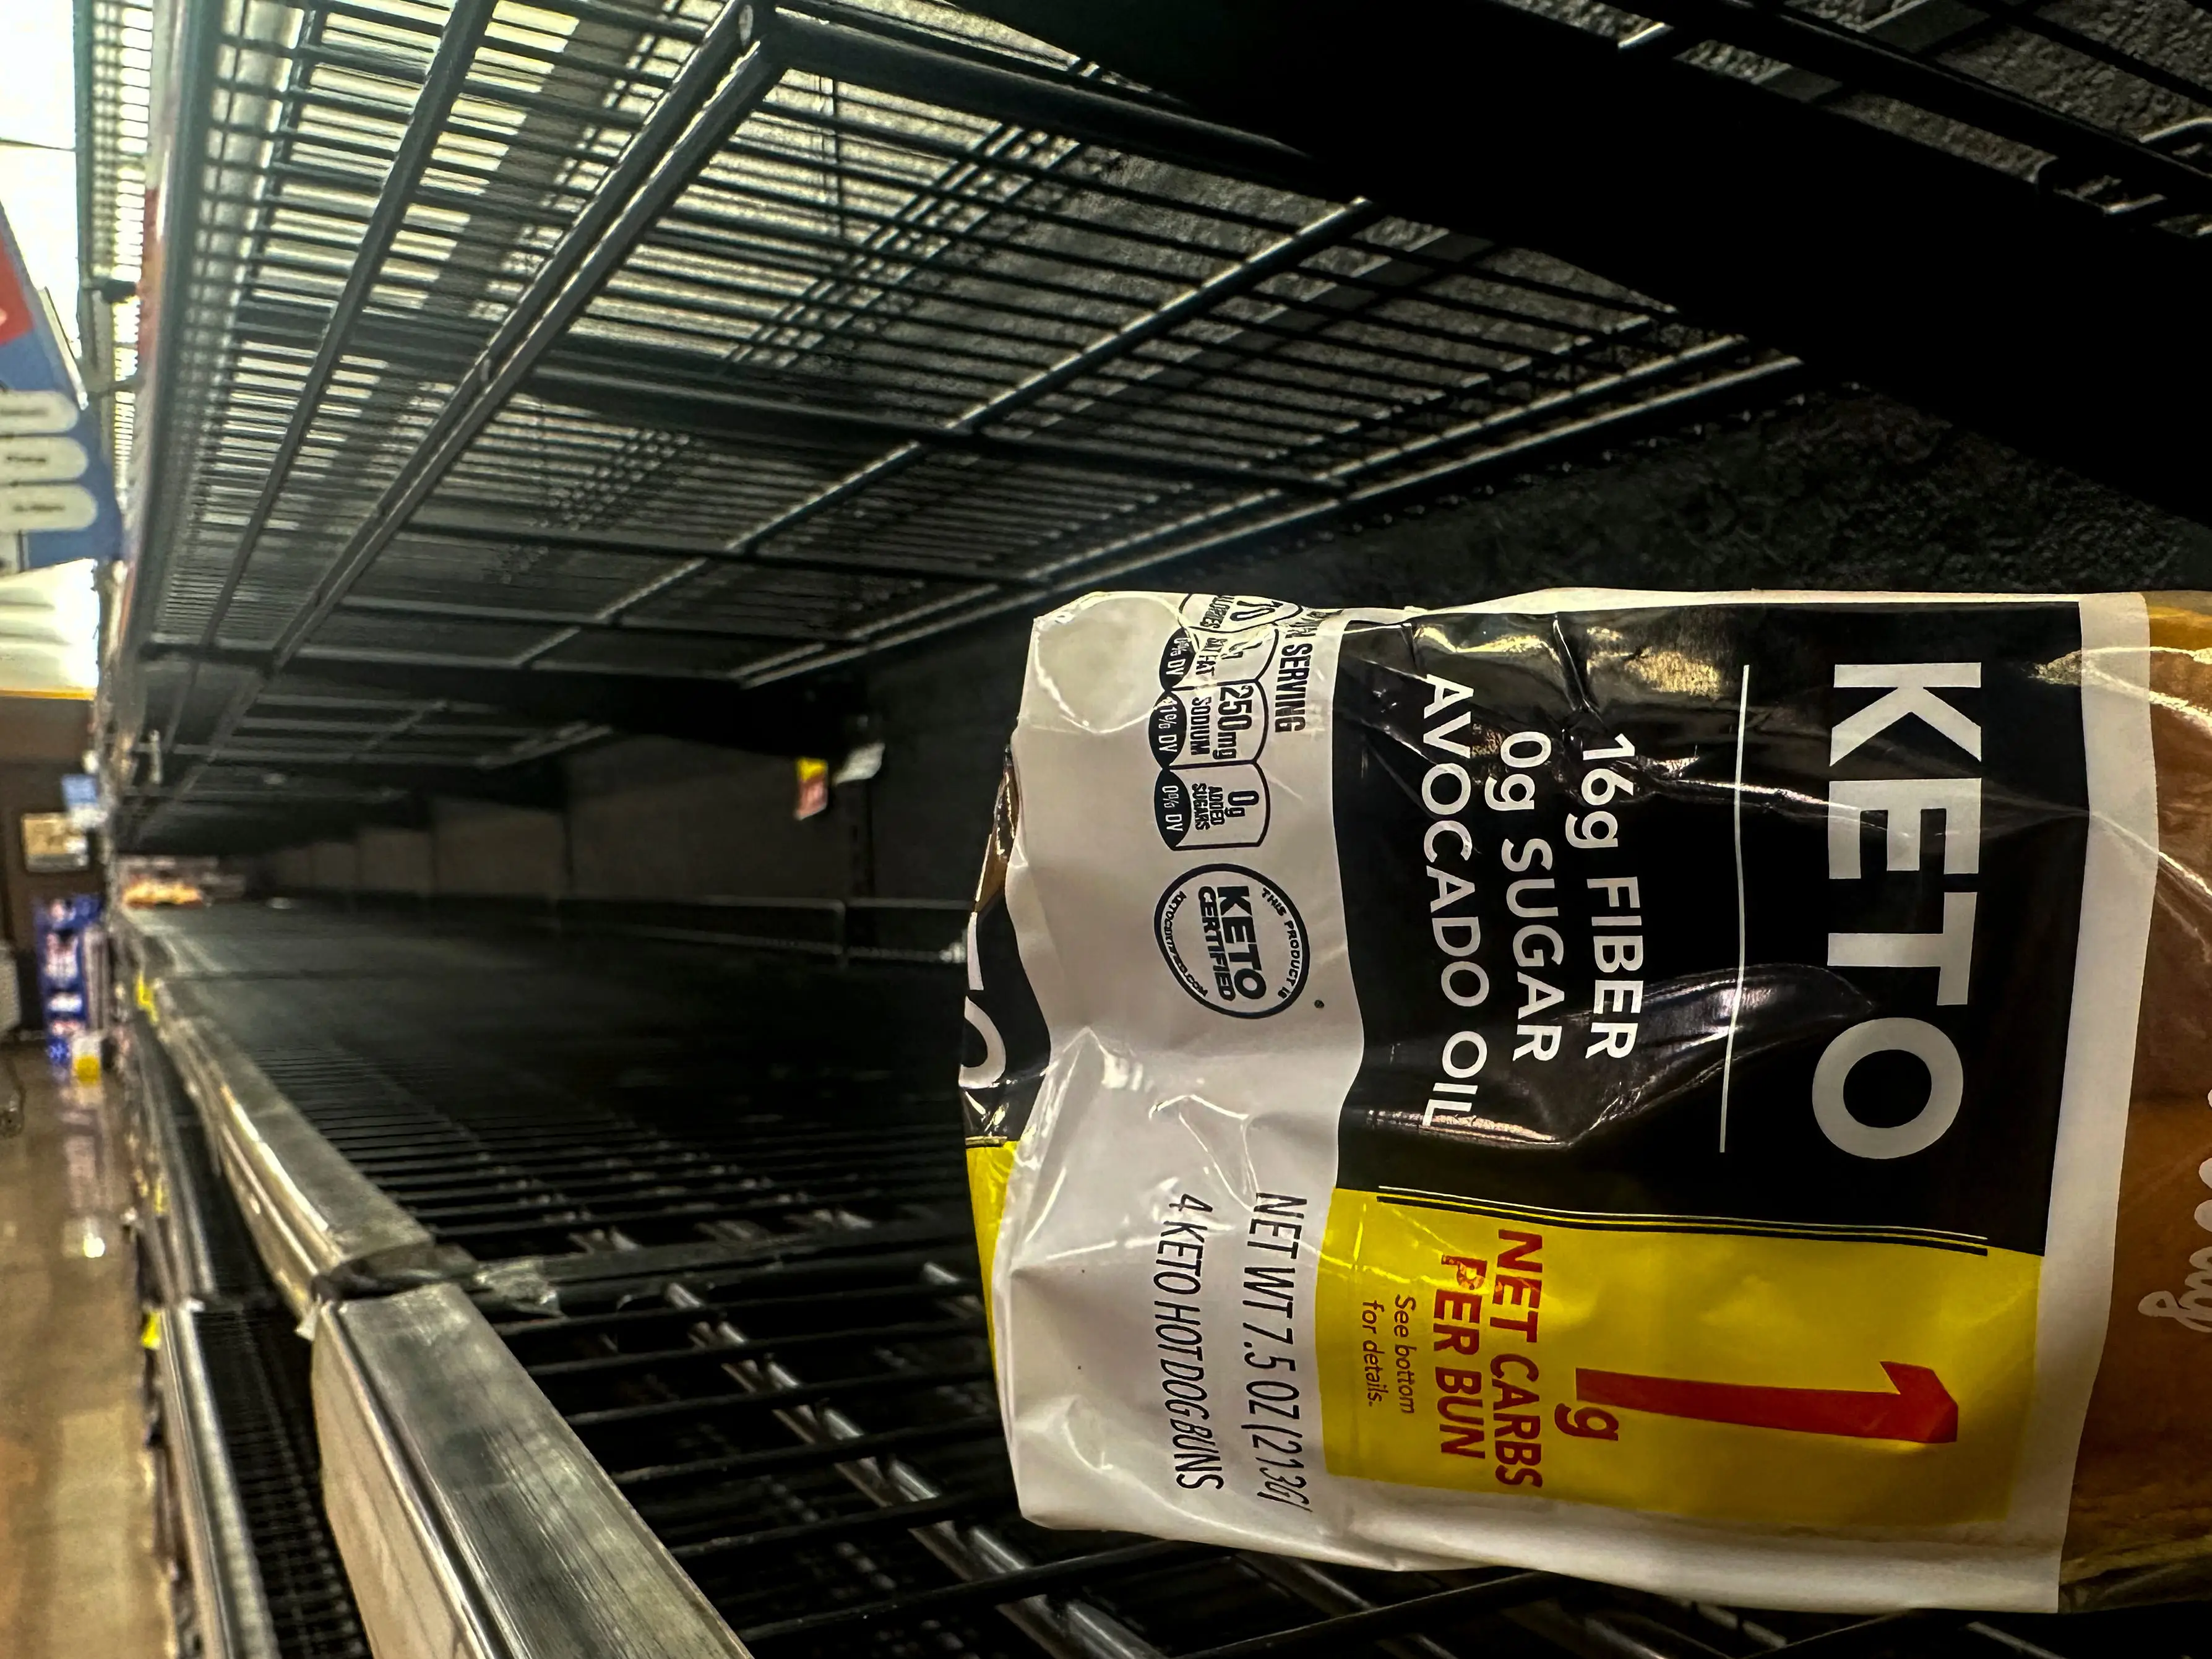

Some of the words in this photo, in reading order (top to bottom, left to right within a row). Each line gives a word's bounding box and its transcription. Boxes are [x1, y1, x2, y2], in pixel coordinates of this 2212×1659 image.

[1166, 658, 1186, 675] DV
[1196, 655, 1218, 676] FAT
[1275, 644, 1312, 733] SERVING
[1158, 734, 1177, 752] DV
[1190, 696, 1212, 755] SODIUM
[1213, 686, 1254, 760] 250mg
[1161, 785, 1179, 808] 0%
[1226, 791, 1259, 817] 0g
[1484, 731, 1552, 810] 0g
[1565, 733, 1635, 848] 16g
[1165, 814, 1183, 832] DV
[1192, 783, 1210, 830] SUGARS
[1209, 786, 1224, 825] ADDED
[1422, 674, 1489, 1007] AVOCADO
[1199, 886, 1236, 1001] CERTIFIED
[1217, 886, 1267, 999] KETO
[1262, 887, 1286, 916] THIS
[1284, 920, 1300, 986] PRODUCT
[1812, 663, 1981, 1159] KETO
[1502, 838, 1565, 1061] SUGAR
[1585, 876, 1643, 1059] FIBER
[1422, 1031, 1487, 1126] OIL
[1169, 1194, 1213, 1212] 4
[1247, 1193, 1307, 1259] NET
[1153, 1221, 1207, 1295] KETO
[1489, 1229, 1543, 1342] NET
[1242, 1267, 1296, 1319] WT
[1362, 1299, 1384, 1333] for
[1394, 1294, 1416, 1337] See
[1433, 1255, 1487, 1355] PER
[1154, 1300, 1203, 1363] HOT
[1242, 1322, 1296, 1372] 7.5
[1160, 1358, 1210, 1421] DOG
[1245, 1381, 1301, 1420] OZ
[1363, 1340, 1385, 1407] details.
[1396, 1344, 1417, 1414] bottom
[1434, 1367, 1486, 1459] BUN
[1490, 1354, 1543, 1488] CARBS
[1170, 1418, 1224, 1490] BUNS
